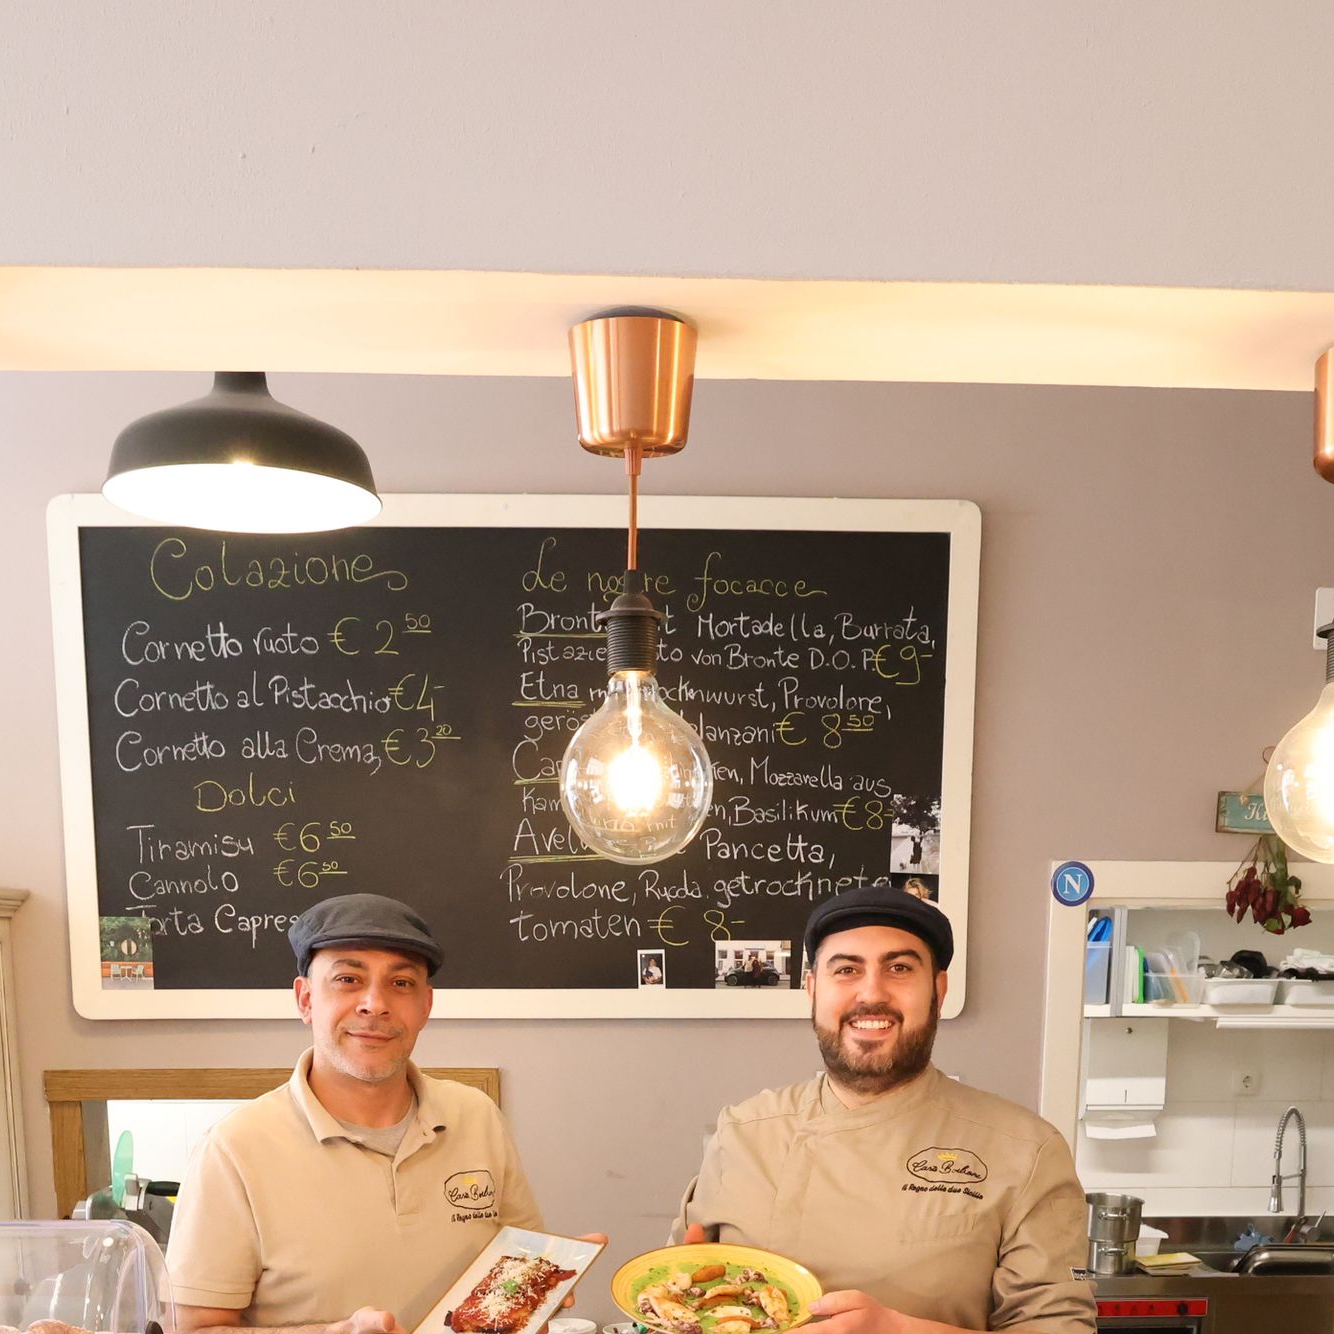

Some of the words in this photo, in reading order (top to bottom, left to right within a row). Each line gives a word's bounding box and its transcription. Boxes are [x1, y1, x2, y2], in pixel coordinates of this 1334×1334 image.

[151, 537, 407, 600] Colazione
[587, 571, 676, 602] nosre
[687, 551, 828, 612] focacce
[516, 602, 607, 635] Bront
[122, 621, 243, 665] Cornetto
[691, 648, 721, 666] von
[723, 643, 800, 671] Bronte
[115, 678, 228, 717] Cornetto
[237, 670, 264, 707] al
[520, 671, 579, 700] Etna
[115, 731, 225, 771] Cornetto
[242, 731, 288, 759] alla
[194, 772, 296, 813] Dolci
[750, 757, 843, 792] Mozzarella
[852, 774, 892, 797] aus
[126, 824, 255, 864] Tiramisu
[700, 829, 835, 869] Pancetta,
[128, 864, 239, 900] Cannolo
[1063, 872, 1084, 895] N
[510, 908, 640, 942] tomaten
